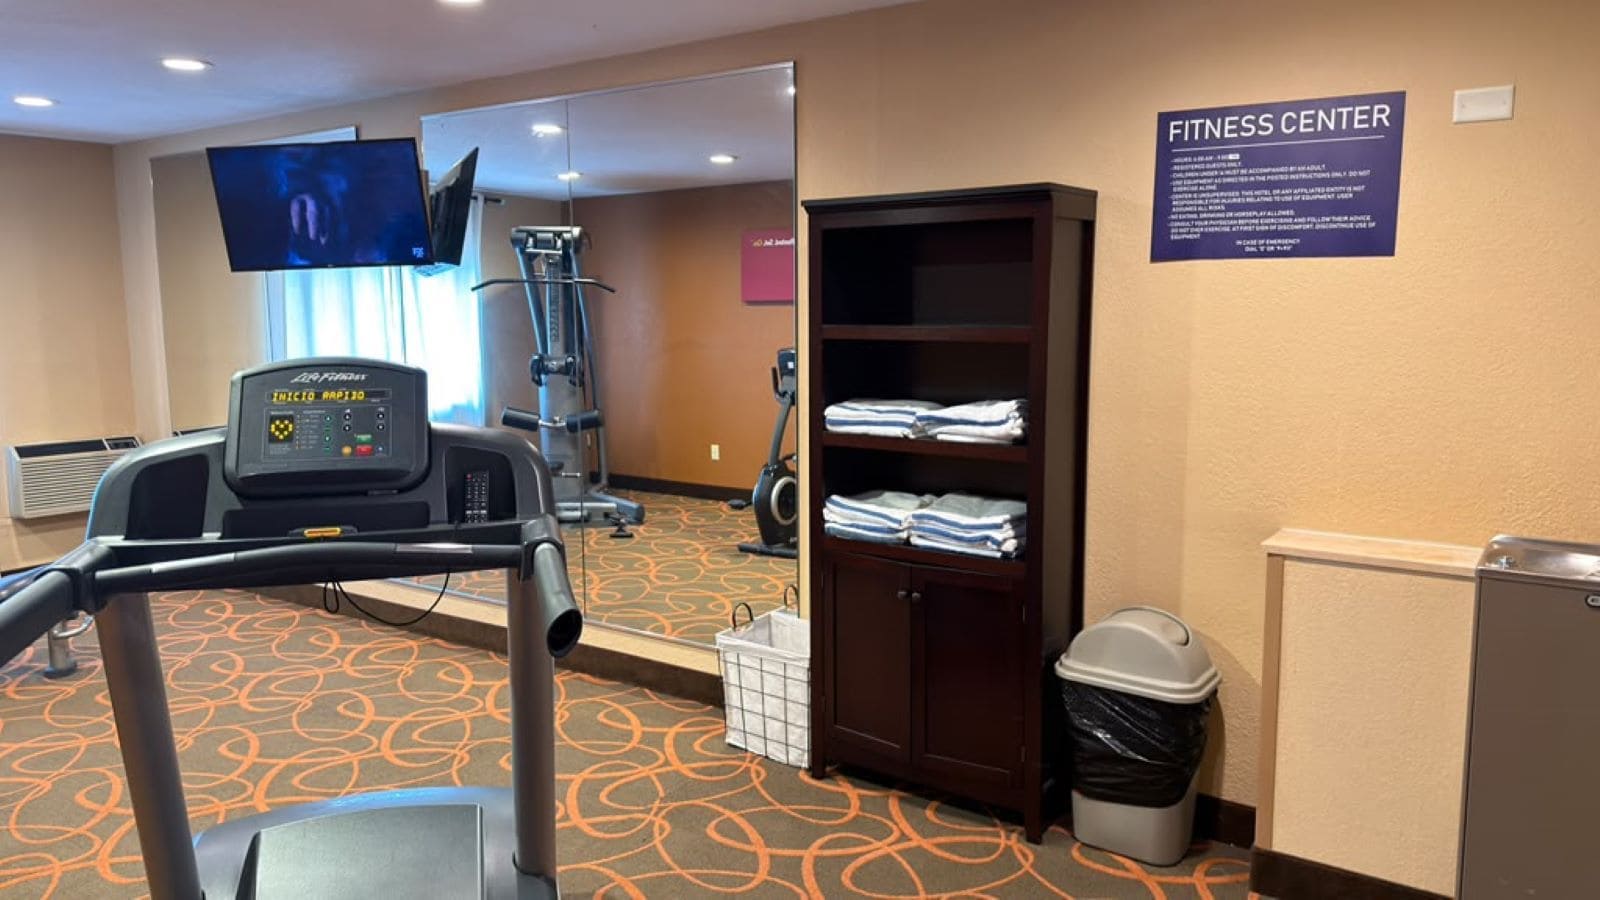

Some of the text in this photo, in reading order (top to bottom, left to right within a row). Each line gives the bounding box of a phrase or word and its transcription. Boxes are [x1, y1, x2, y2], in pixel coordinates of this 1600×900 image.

[1169, 104, 1391, 142] FITNESS CENTER
[1289, 172, 1330, 180] INSTRUCTIONS
[272, 392, 315, 402] INICIO
